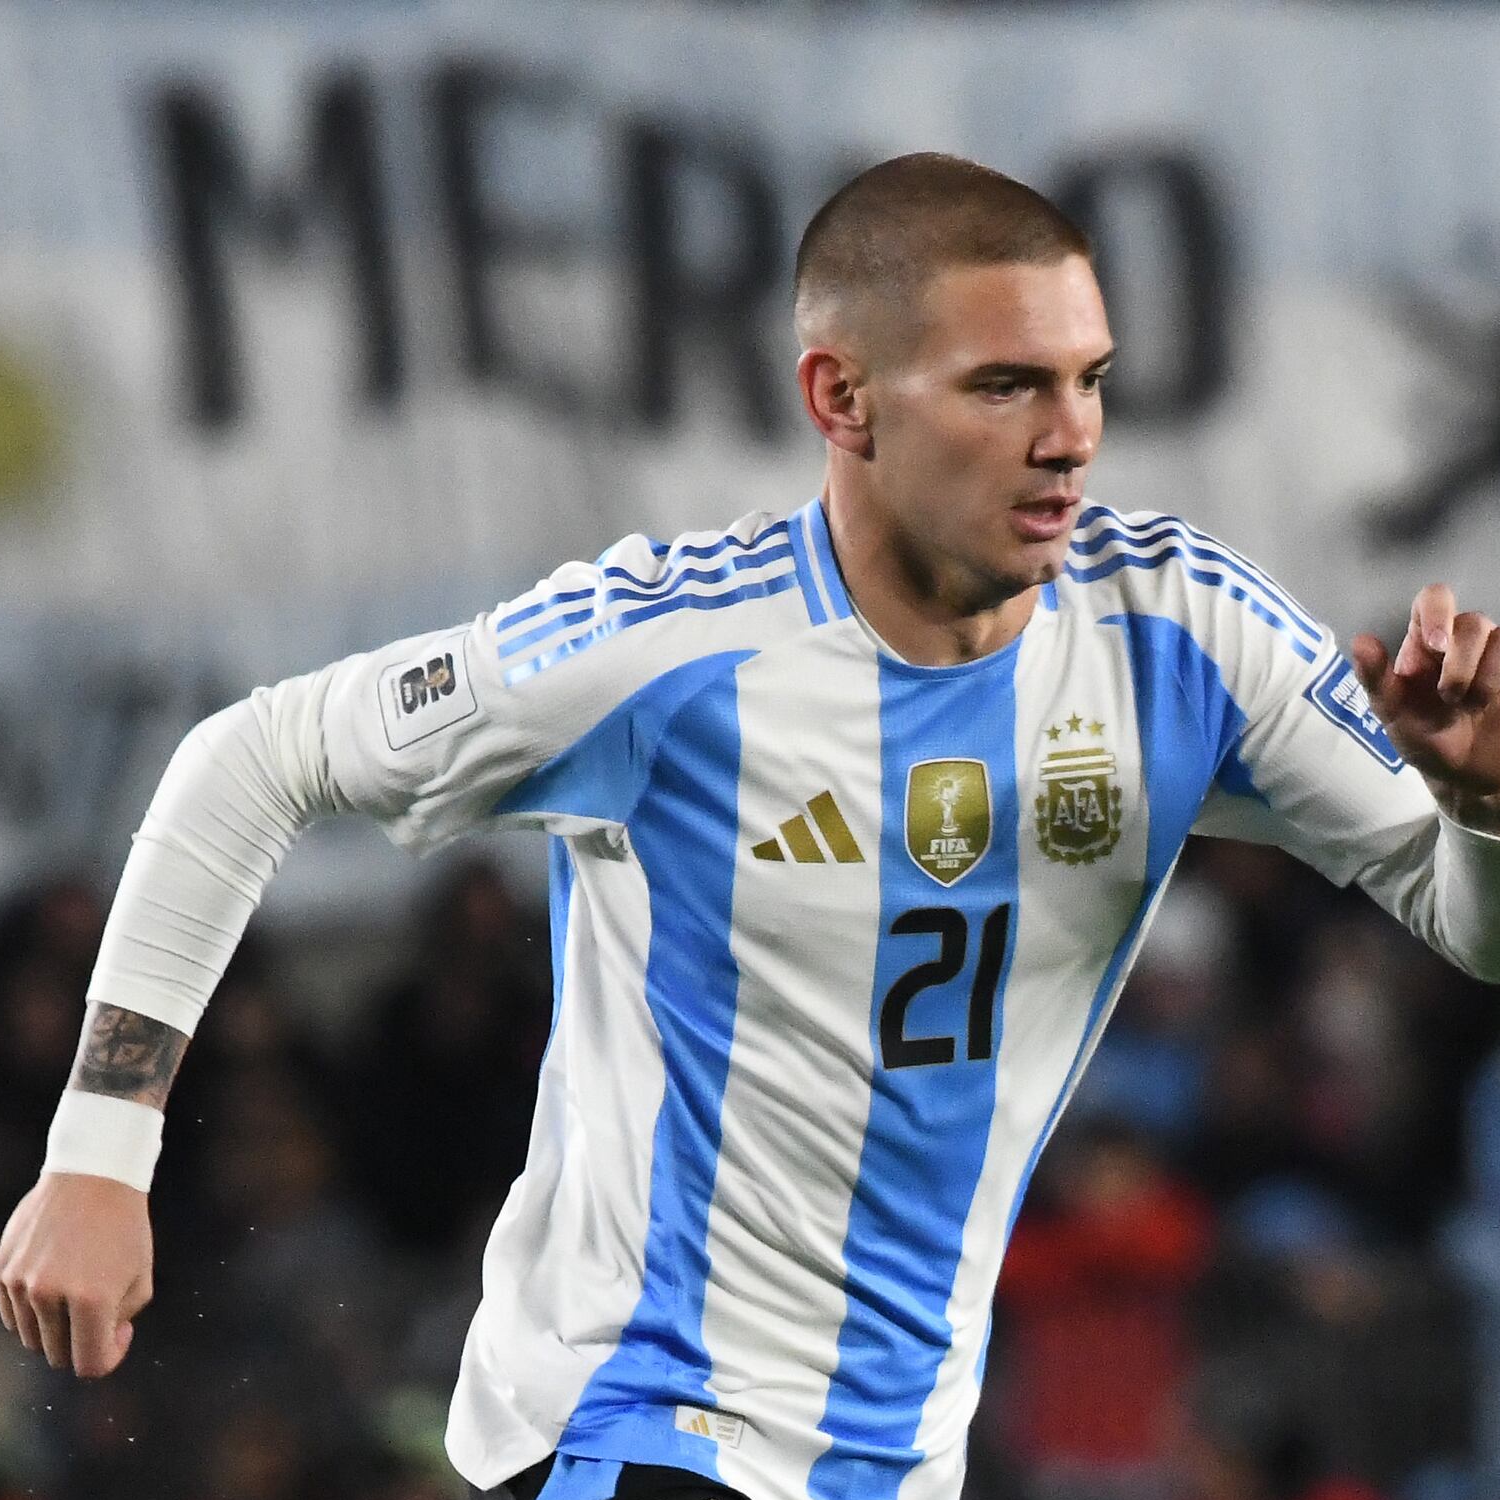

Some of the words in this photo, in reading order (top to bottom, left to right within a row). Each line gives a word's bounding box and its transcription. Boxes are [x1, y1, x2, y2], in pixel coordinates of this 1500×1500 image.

[150, 50, 1238, 445] MERO
[929, 838, 970, 854] FIFA
[1053, 779, 1106, 833] AFA
[879, 902, 1011, 1071] 21
